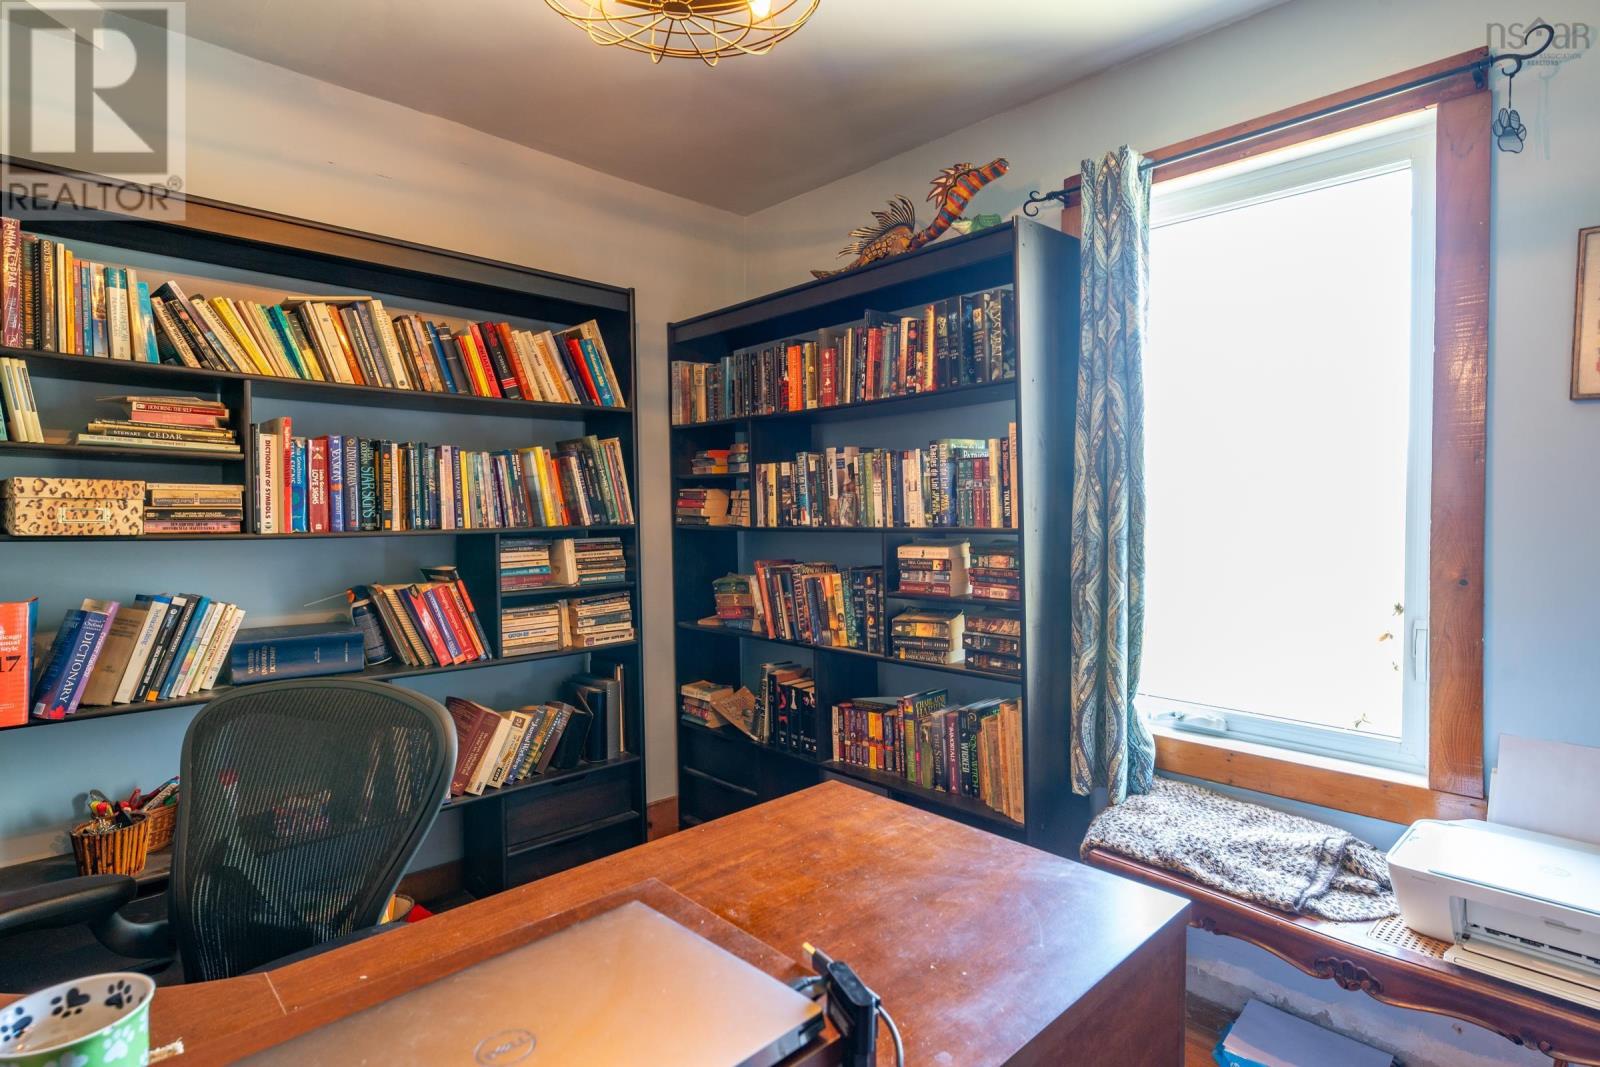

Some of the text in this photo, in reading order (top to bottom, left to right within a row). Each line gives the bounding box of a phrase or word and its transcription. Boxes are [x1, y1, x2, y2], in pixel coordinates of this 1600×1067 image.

[147, 432, 182, 440] CEDAR
[360, 465, 376, 517] STAR SIGNS
[58, 631, 95, 704] DICTIONARY
[961, 742, 970, 773] WICKED
